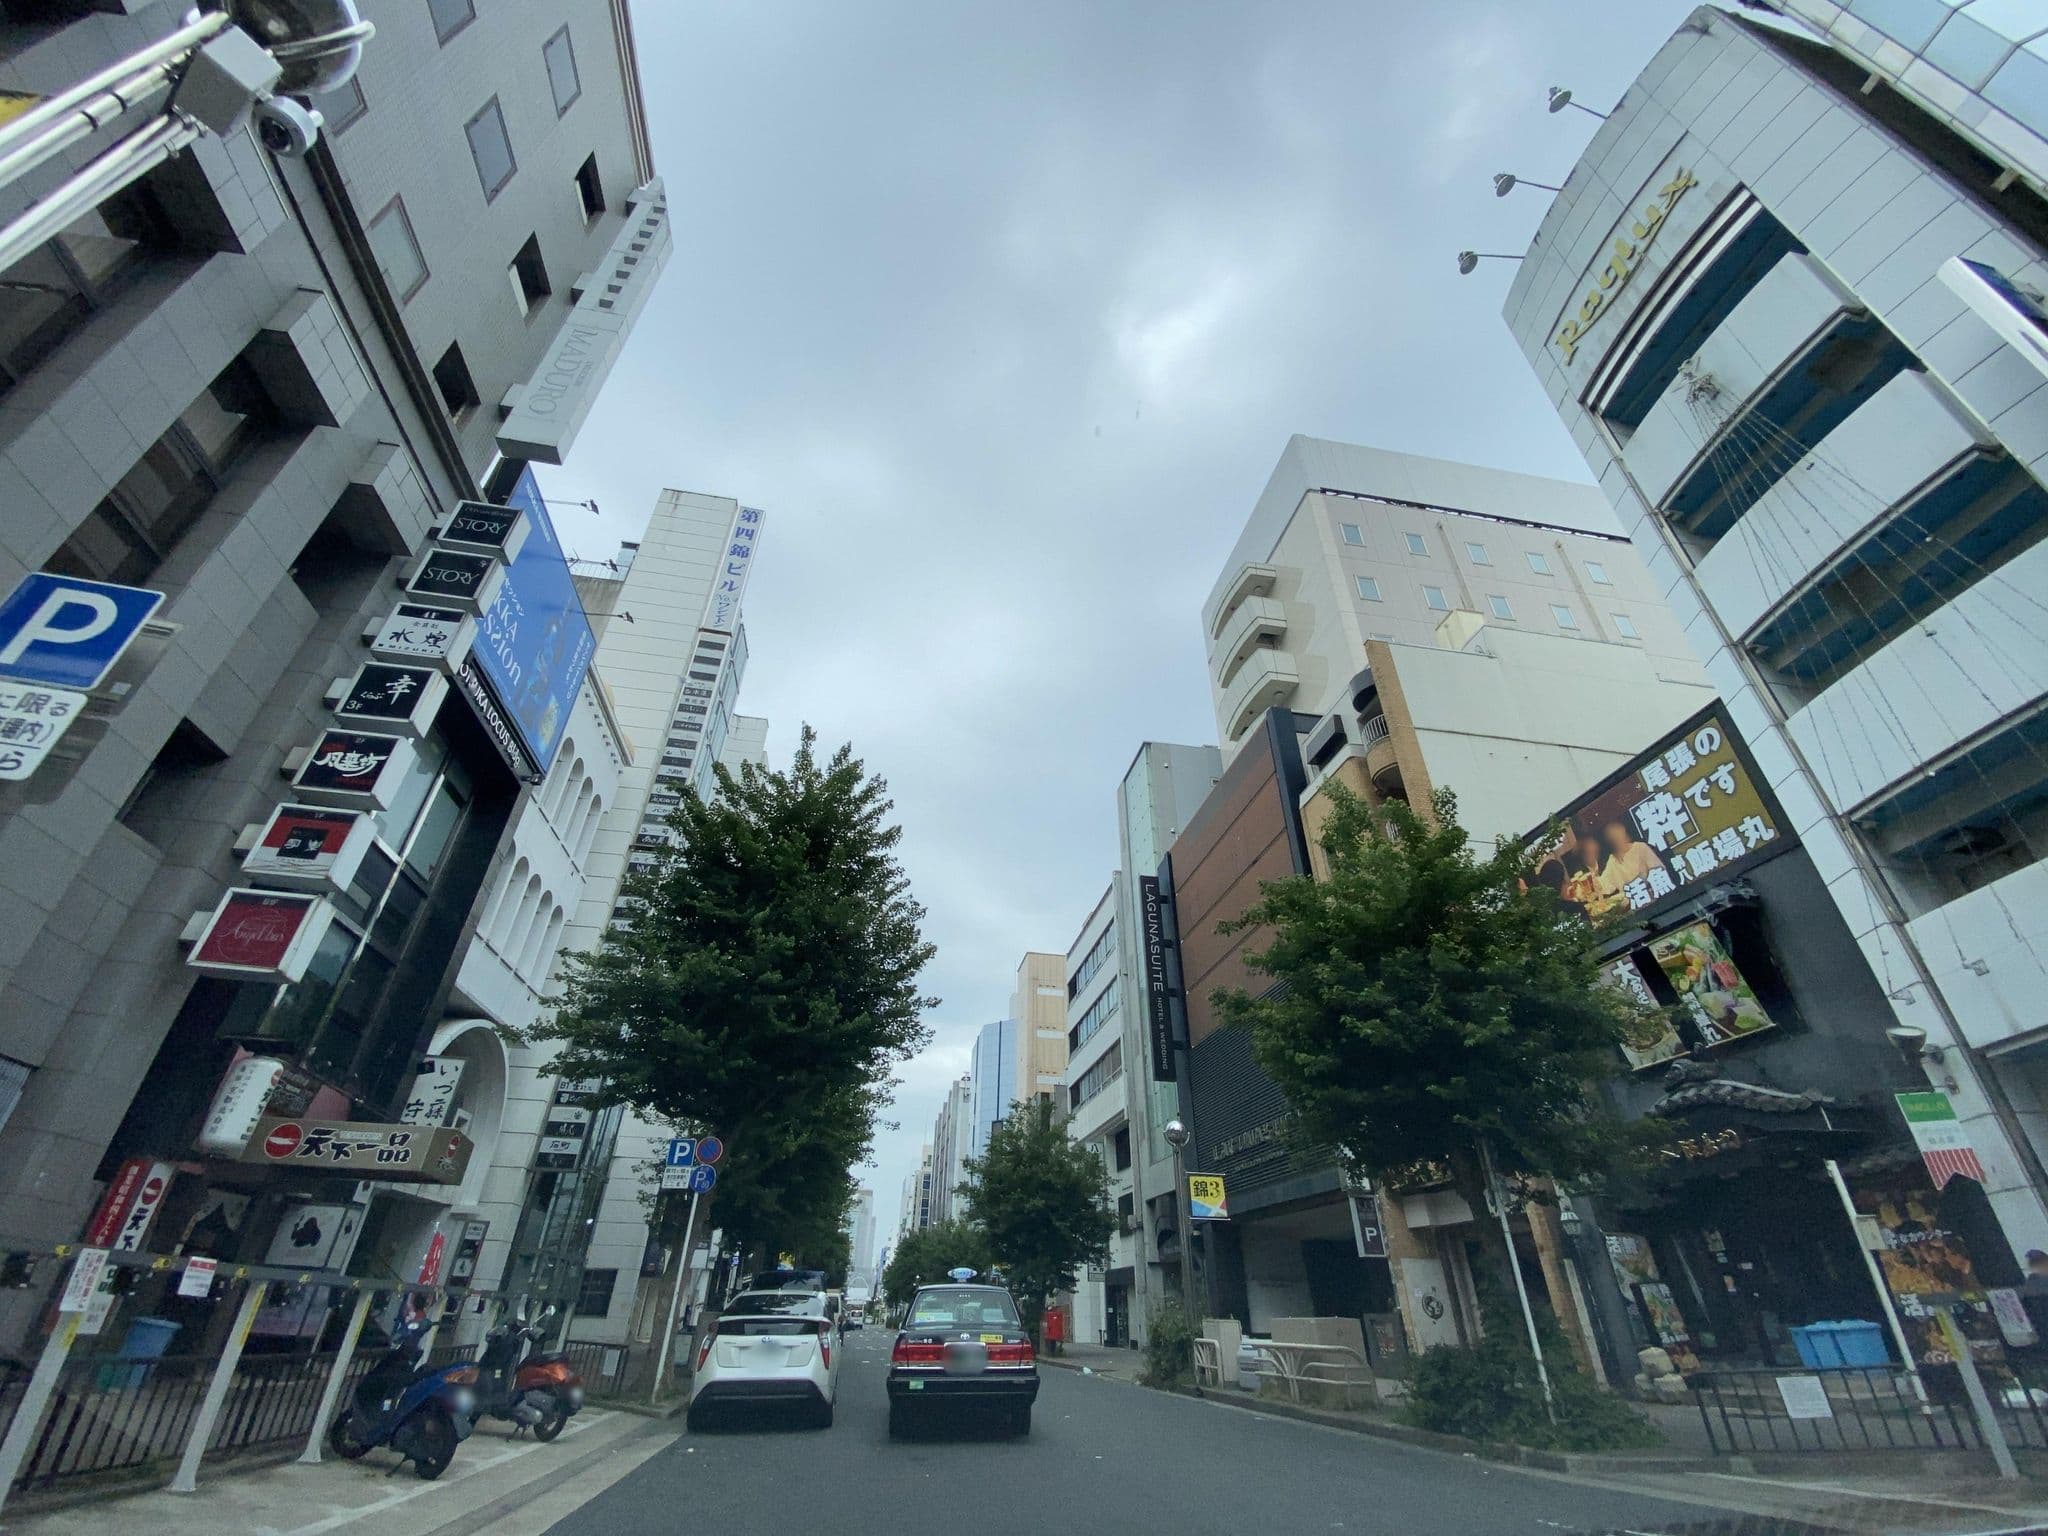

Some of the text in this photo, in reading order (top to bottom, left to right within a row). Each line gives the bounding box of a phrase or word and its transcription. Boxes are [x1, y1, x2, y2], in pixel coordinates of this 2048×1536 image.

[528, 329, 598, 415] MADURO
[454, 517, 508, 534] STORY
[720, 509, 761, 592] 第四錦ビル
[424, 567, 480, 585] STORY
[0, 587, 118, 665] P
[346, 700, 363, 711] 3F
[486, 709, 511, 745] LOCUS
[1641, 726, 1721, 793] 尾張の
[1623, 866, 1677, 910] 活魚
[1686, 815, 1776, 878] 飯場丸
[1145, 884, 1164, 992] LAGUNASUITE
[1157, 997, 1165, 1022] HOTEL
[1160, 1031, 1169, 1071] WEDDING
[297, 1127, 412, 1164] 天下一品
[673, 1142, 691, 1164] P
[694, 1171, 707, 1189] P
[1193, 1180, 1221, 1199] 錦3
[1365, 1227, 1378, 1242] P
